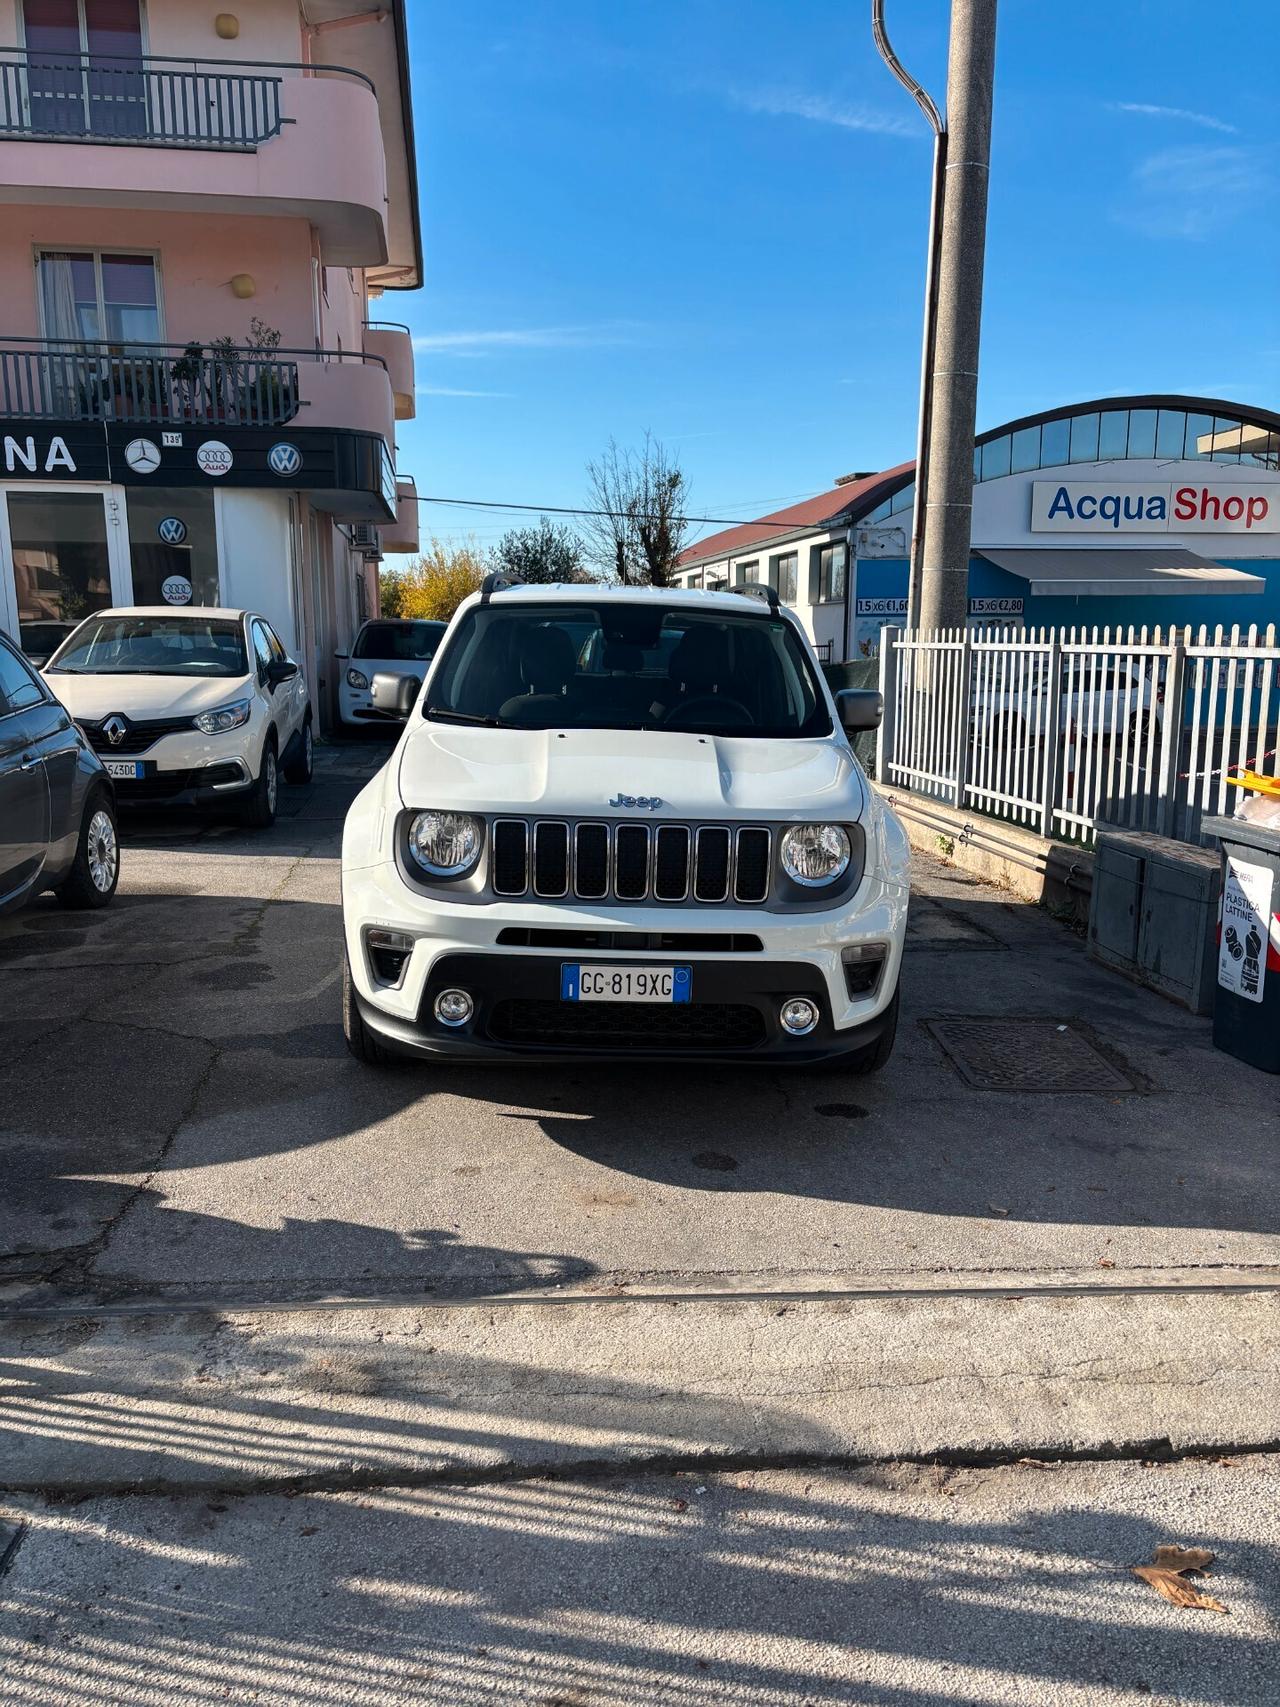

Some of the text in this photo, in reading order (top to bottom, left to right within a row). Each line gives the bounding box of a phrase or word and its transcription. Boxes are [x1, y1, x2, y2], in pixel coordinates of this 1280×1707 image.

[4, 435, 77, 472] NA
[203, 463, 229, 471] Audi
[1047, 486, 1269, 529] Acqua Shop
[873, 600, 884, 611] x6
[985, 600, 997, 611] x6
[998, 599, 1022, 612] €2,80
[608, 792, 663, 812] Jeep
[1226, 892, 1260, 913] PLASTICA
[1225, 903, 1253, 922] LATTINE
